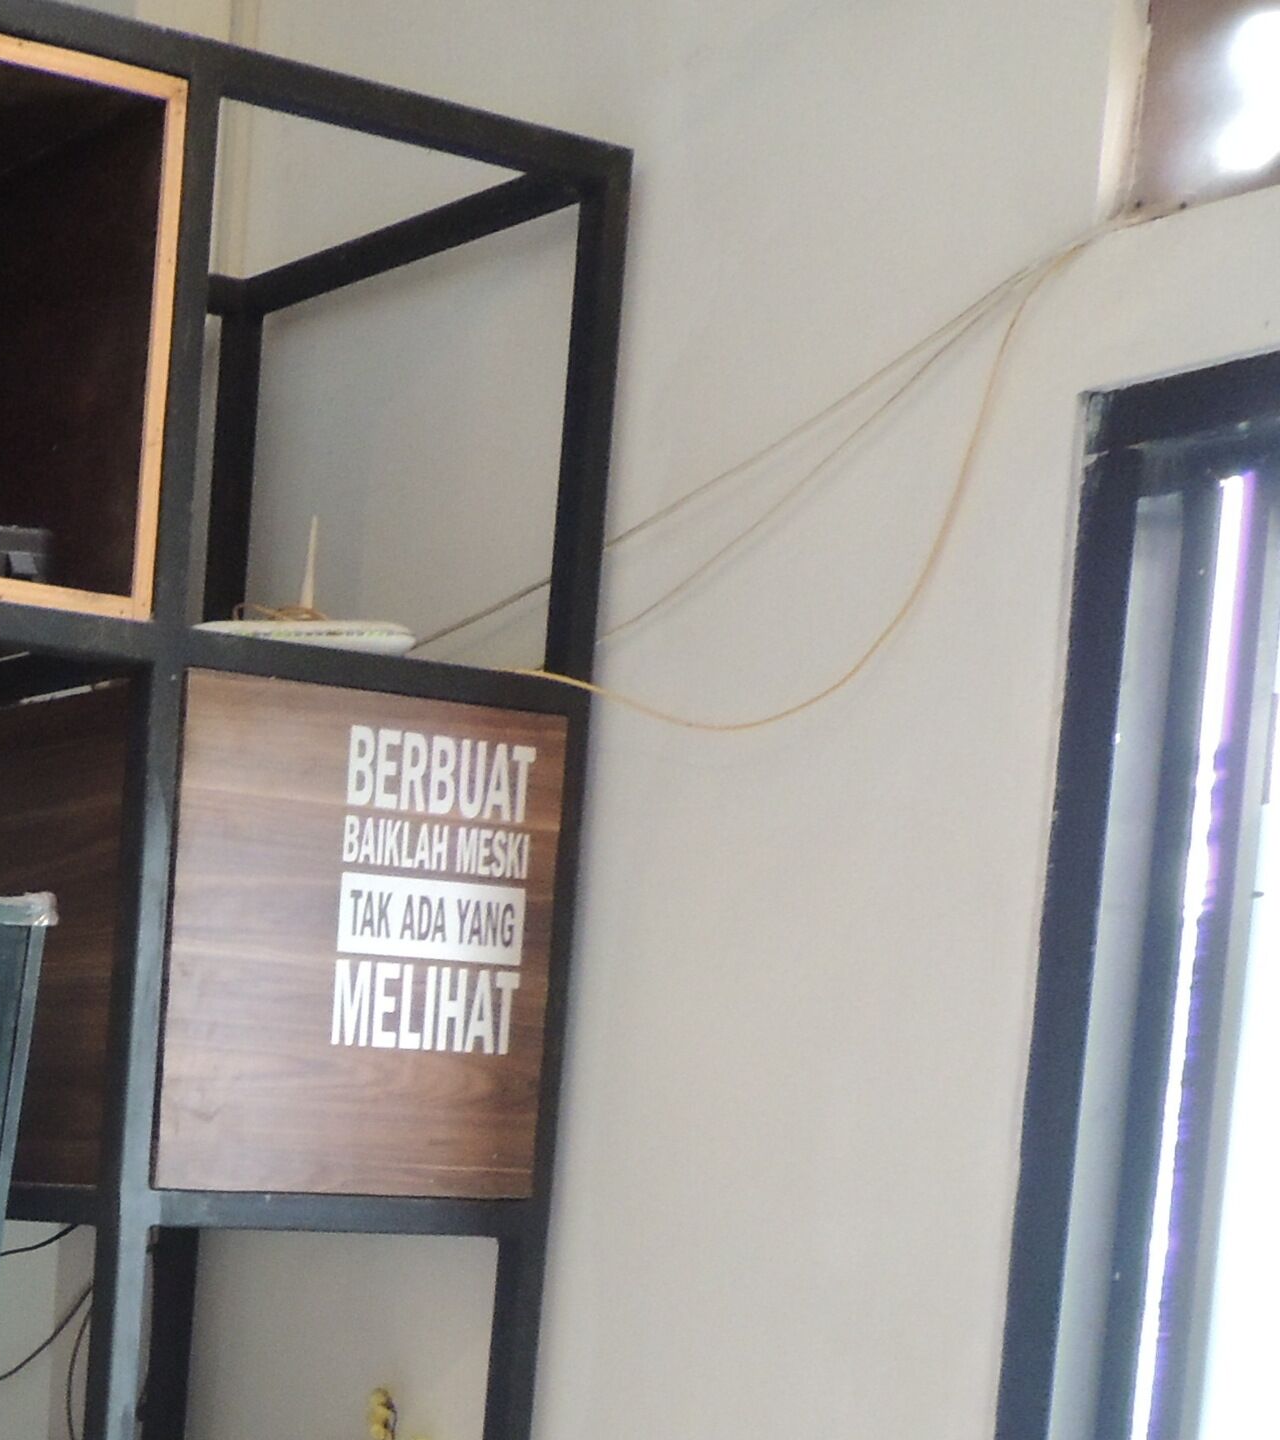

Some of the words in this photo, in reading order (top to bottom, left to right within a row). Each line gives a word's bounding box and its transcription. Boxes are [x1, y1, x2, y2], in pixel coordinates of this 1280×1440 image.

[346, 725, 537, 823] BERBUAT
[343, 815, 446, 872] BAIKLAH
[456, 827, 530, 880] MESKI
[349, 889, 393, 939] TAK
[400, 894, 447, 943] ADA
[457, 899, 516, 948] YANG
[330, 959, 521, 1056] MELIHAT
